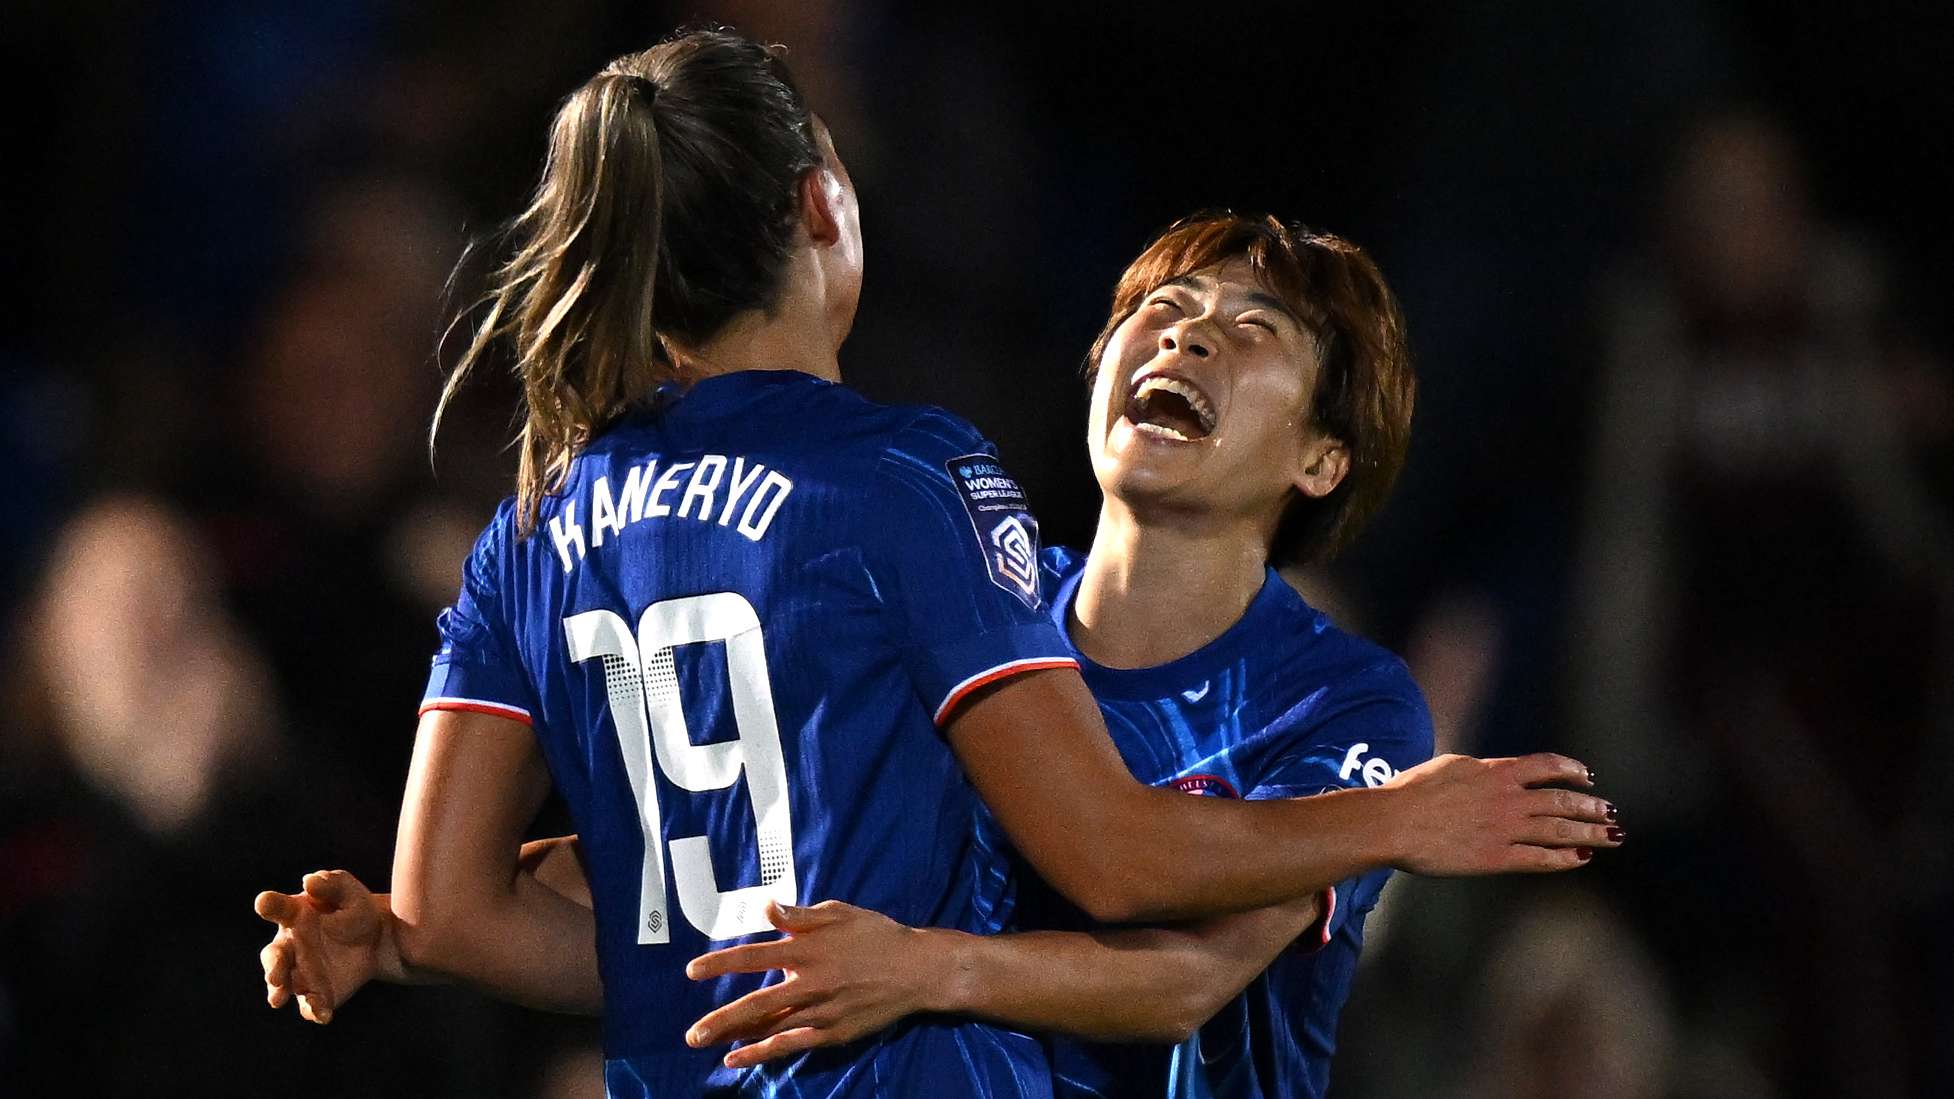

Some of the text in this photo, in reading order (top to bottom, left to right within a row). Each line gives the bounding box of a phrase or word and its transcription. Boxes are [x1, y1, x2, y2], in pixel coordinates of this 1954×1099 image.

[549, 455, 793, 573] KANERYD
[970, 490, 998, 500] SUPER
[563, 592, 798, 944] 19
[1339, 743, 1399, 789] fe
